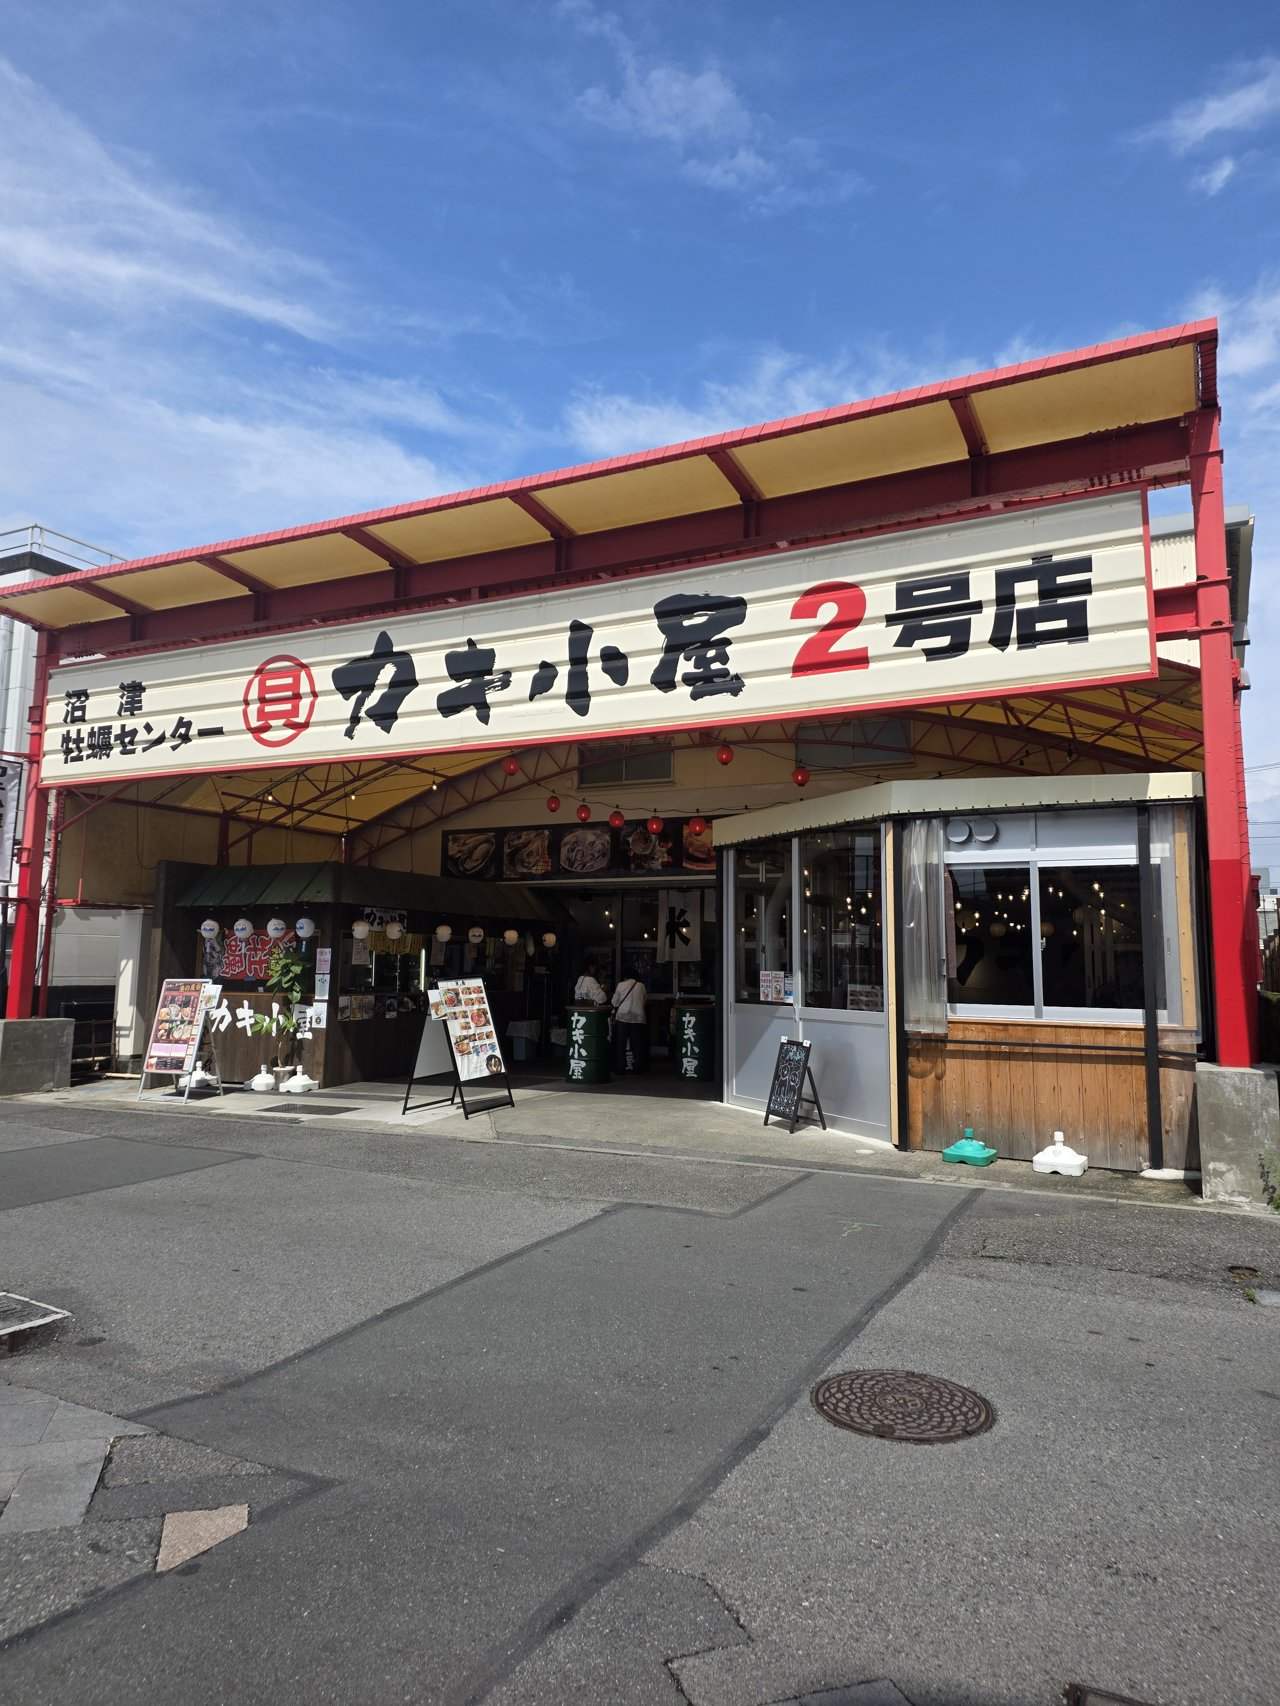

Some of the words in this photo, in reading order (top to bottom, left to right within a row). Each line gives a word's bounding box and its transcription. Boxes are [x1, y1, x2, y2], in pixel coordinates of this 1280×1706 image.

[331, 593, 746, 740] カキ小屋
[790, 554, 1094, 678] 2号店
[64, 681, 146, 724] 沼津
[61, 716, 224, 764] 牡蠣センター
[569, 1012, 588, 1080] カキ小屋
[681, 1012, 700, 1078] カキ小屋
